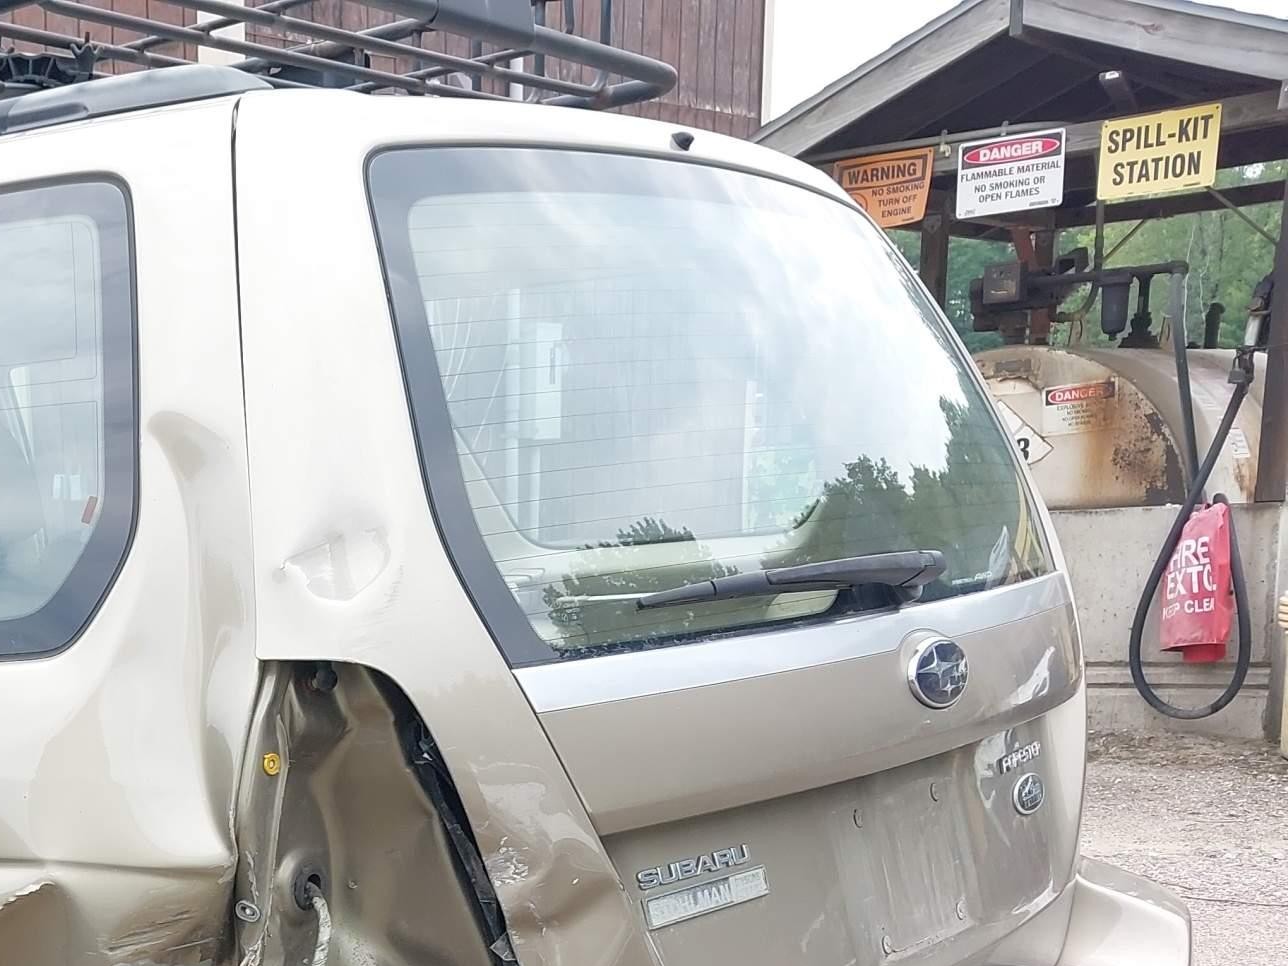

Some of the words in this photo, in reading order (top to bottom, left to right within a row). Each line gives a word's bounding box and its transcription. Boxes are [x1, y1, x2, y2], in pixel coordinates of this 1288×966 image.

[1107, 113, 1214, 154] SPILL-KIT
[979, 141, 1044, 162] DANGER
[847, 162, 918, 185] WARNING
[960, 167, 1013, 183] FLAMMABLE
[1016, 159, 1061, 174] MATERIAL
[1112, 150, 1202, 186] STATION
[871, 186, 884, 197] NO
[886, 181, 925, 195] SMOKING
[974, 184, 987, 194] NO
[988, 178, 1030, 192] SMOKING
[1033, 176, 1046, 185] OR
[978, 192, 1002, 204] OPEN
[1005, 187, 1040, 200] FLAMES
[878, 196, 900, 207] TURN
[902, 194, 918, 204] OFF
[881, 206, 912, 218] ENGINE
[1016, 438, 1030, 461] 3
[636, 843, 752, 890] SUBARU
